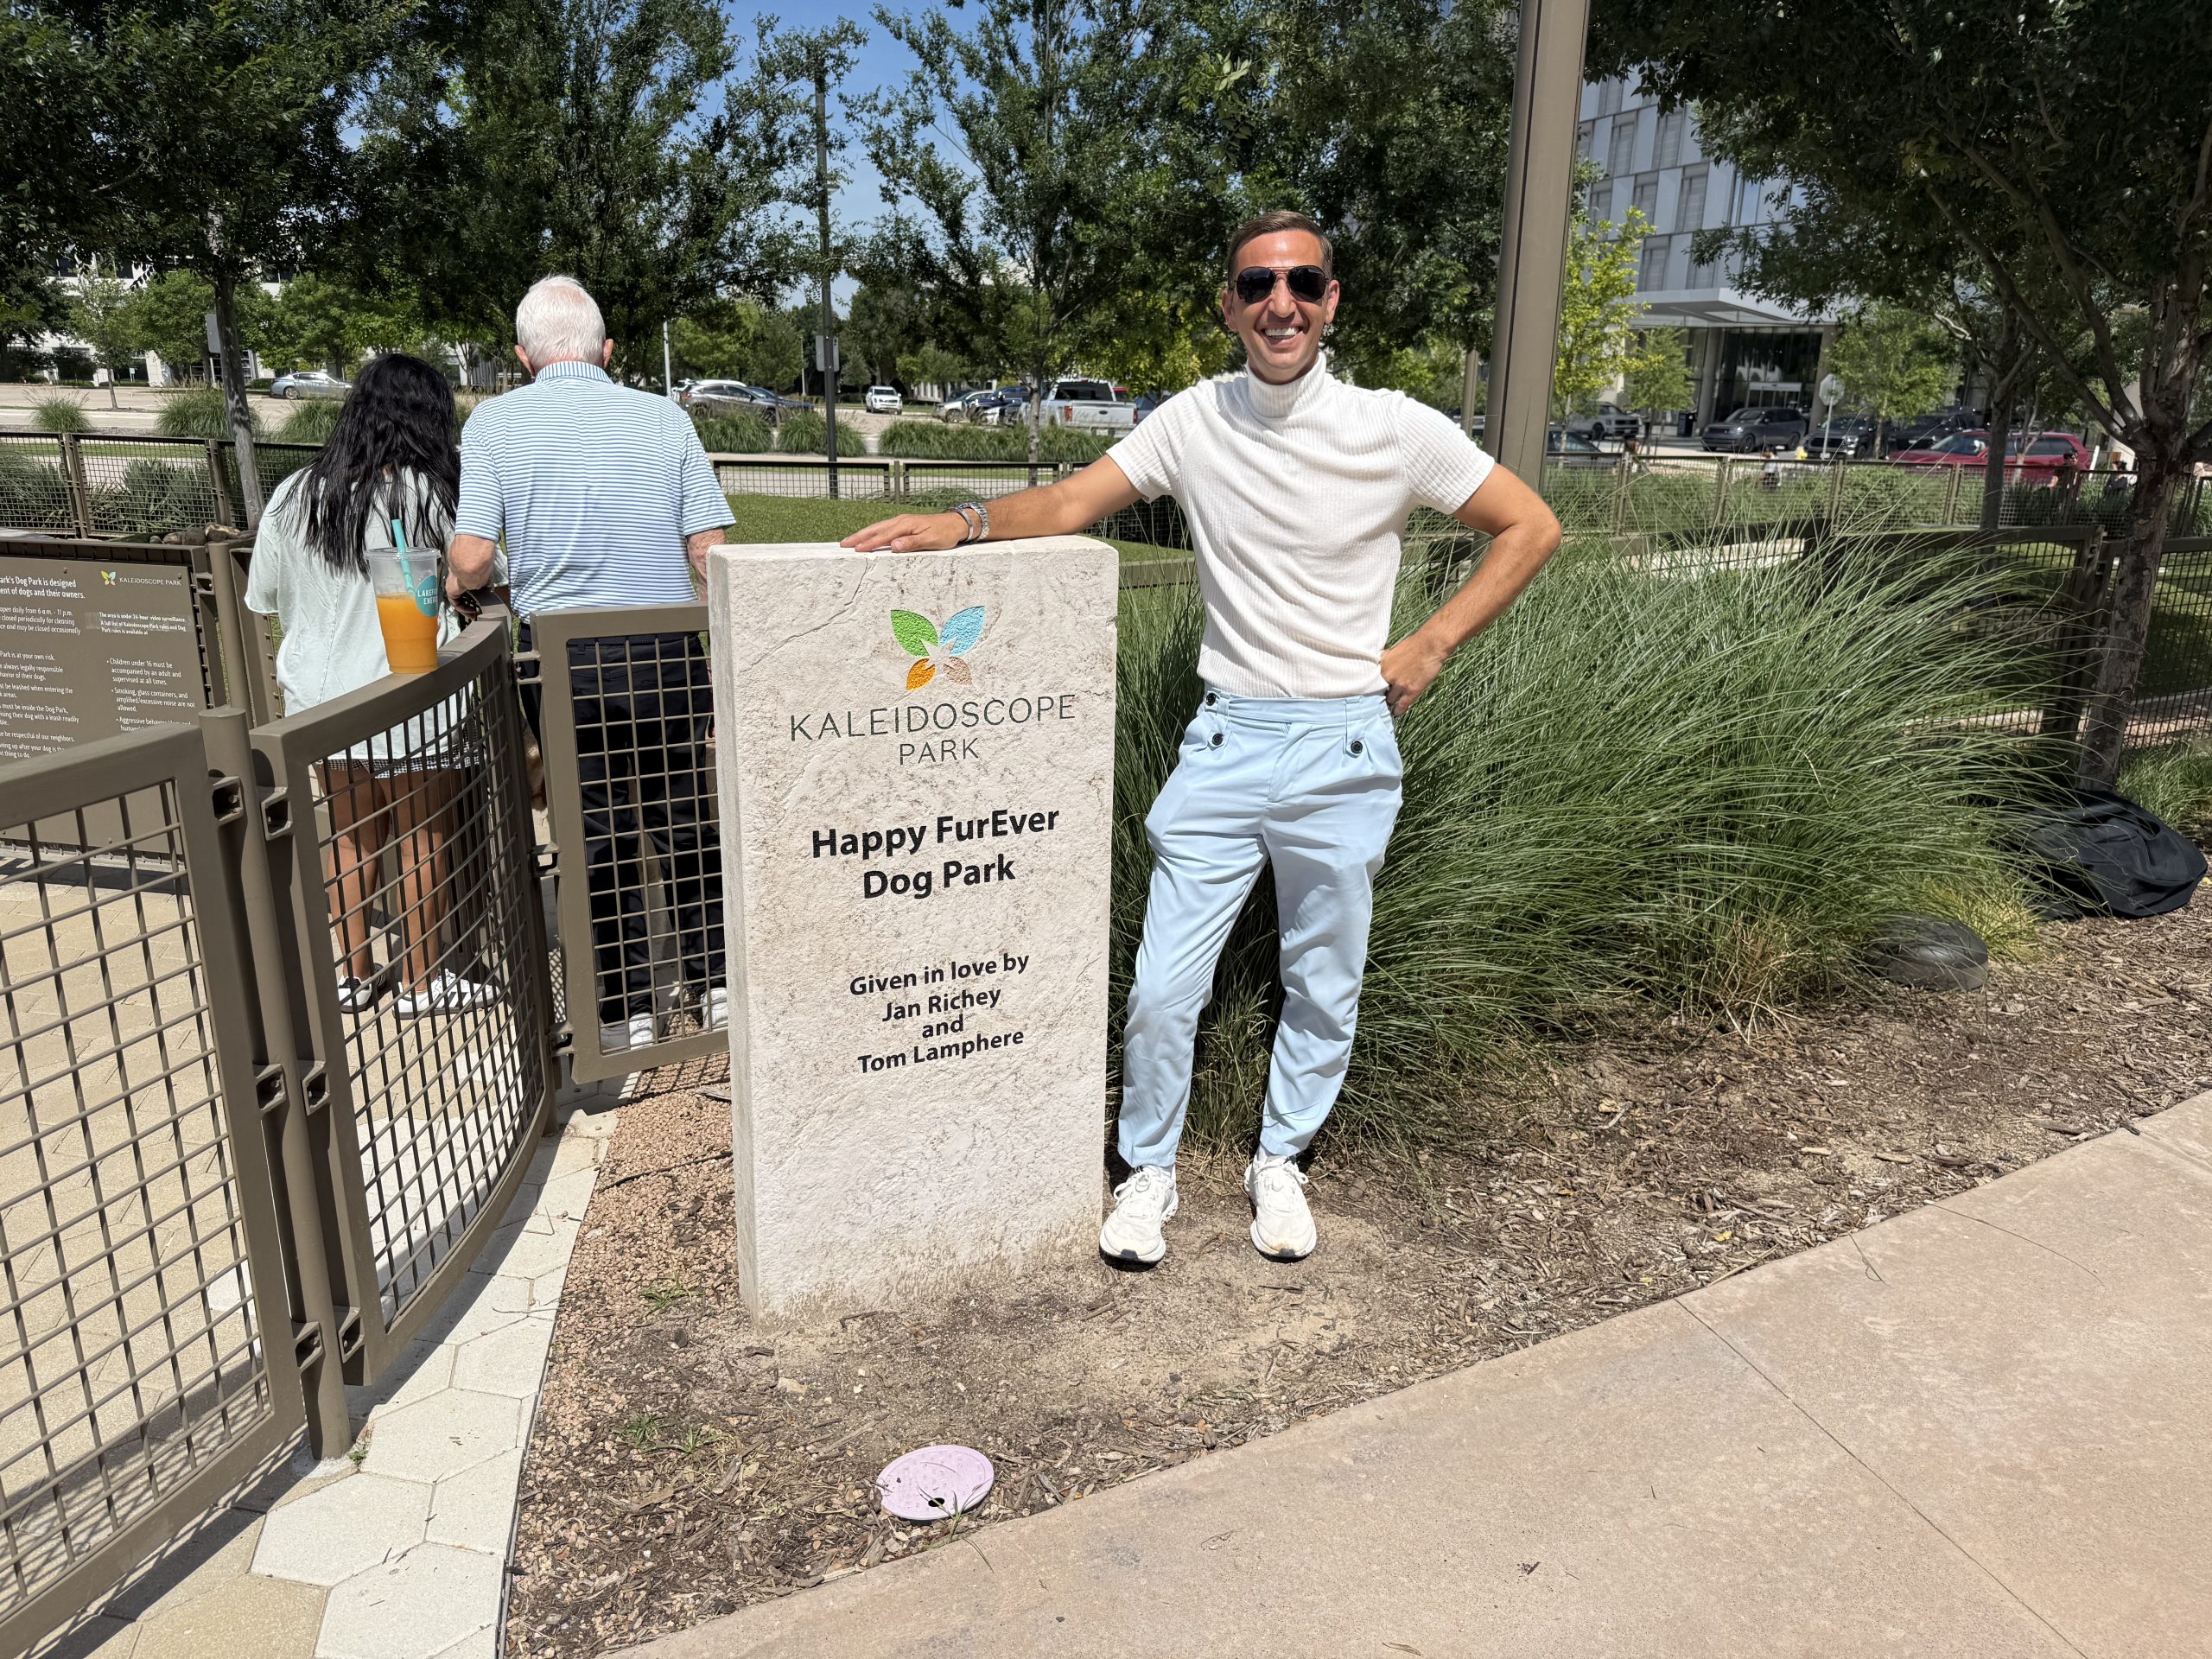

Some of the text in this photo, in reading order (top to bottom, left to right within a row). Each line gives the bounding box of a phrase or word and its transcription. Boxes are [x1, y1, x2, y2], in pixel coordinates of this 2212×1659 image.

[16, 576, 28, 587] Dog
[29, 577, 42, 586] Park
[50, 578, 76, 588] designed
[19, 588, 33, 597] dogs
[17, 616, 45, 625] periodically
[54, 618, 75, 626] cleaning
[115, 687, 137, 696] Smoking,
[25, 712, 34, 721] dog
[45, 705, 55, 714] Dog
[791, 694, 1076, 741] KALEIDOSCOPE
[899, 737, 978, 766] PARK
[812, 809, 1060, 860] Happy FurEver
[863, 853, 1016, 899] Dog Park
[849, 952, 1030, 995] Given in love by
[881, 988, 1001, 1022] Jan Richey
[922, 1013, 963, 1039] and
[857, 1031, 1024, 1074] Tom Lamphere
